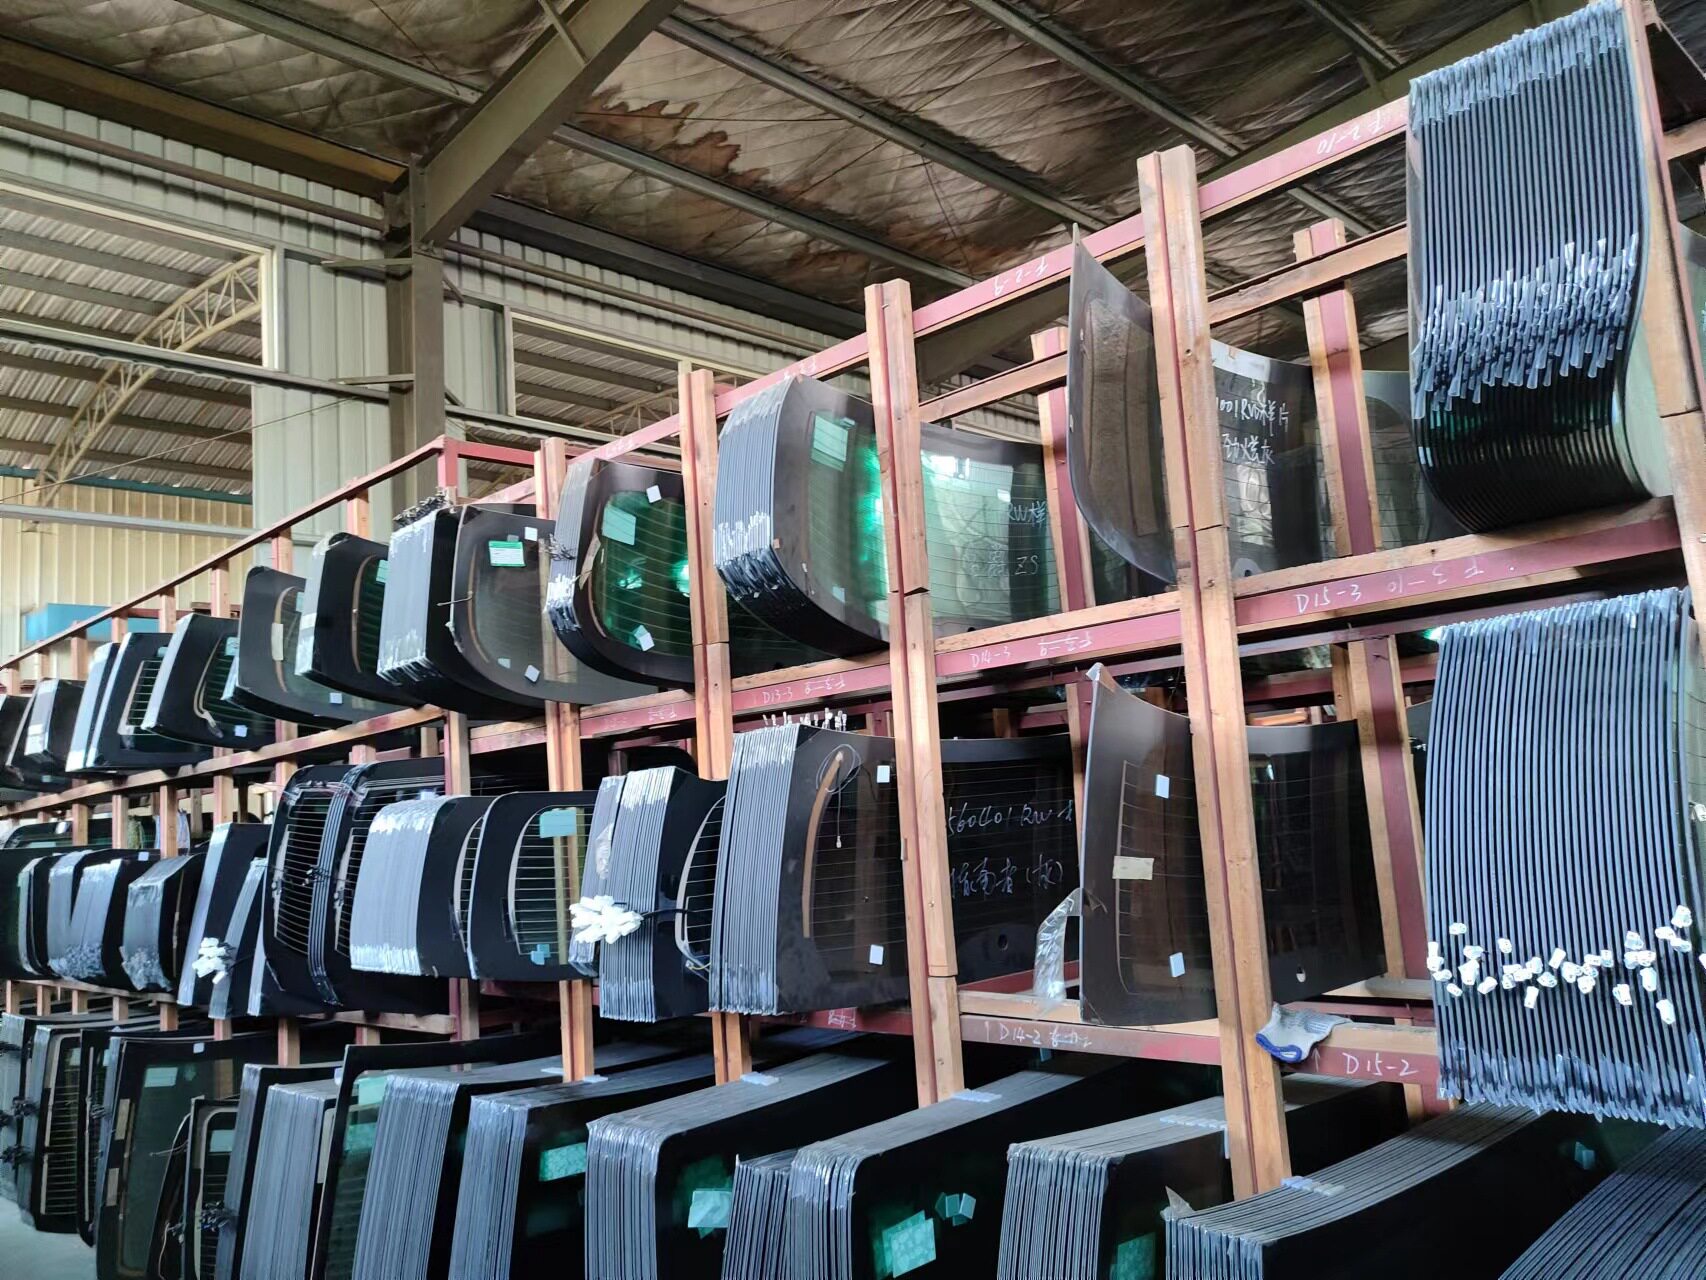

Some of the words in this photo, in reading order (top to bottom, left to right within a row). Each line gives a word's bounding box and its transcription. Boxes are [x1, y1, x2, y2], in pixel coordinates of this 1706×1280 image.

[1296, 585, 1362, 614] D15-3
[999, 1022, 1042, 1045] D14-2
[1342, 1052, 1419, 1077] D15-2
